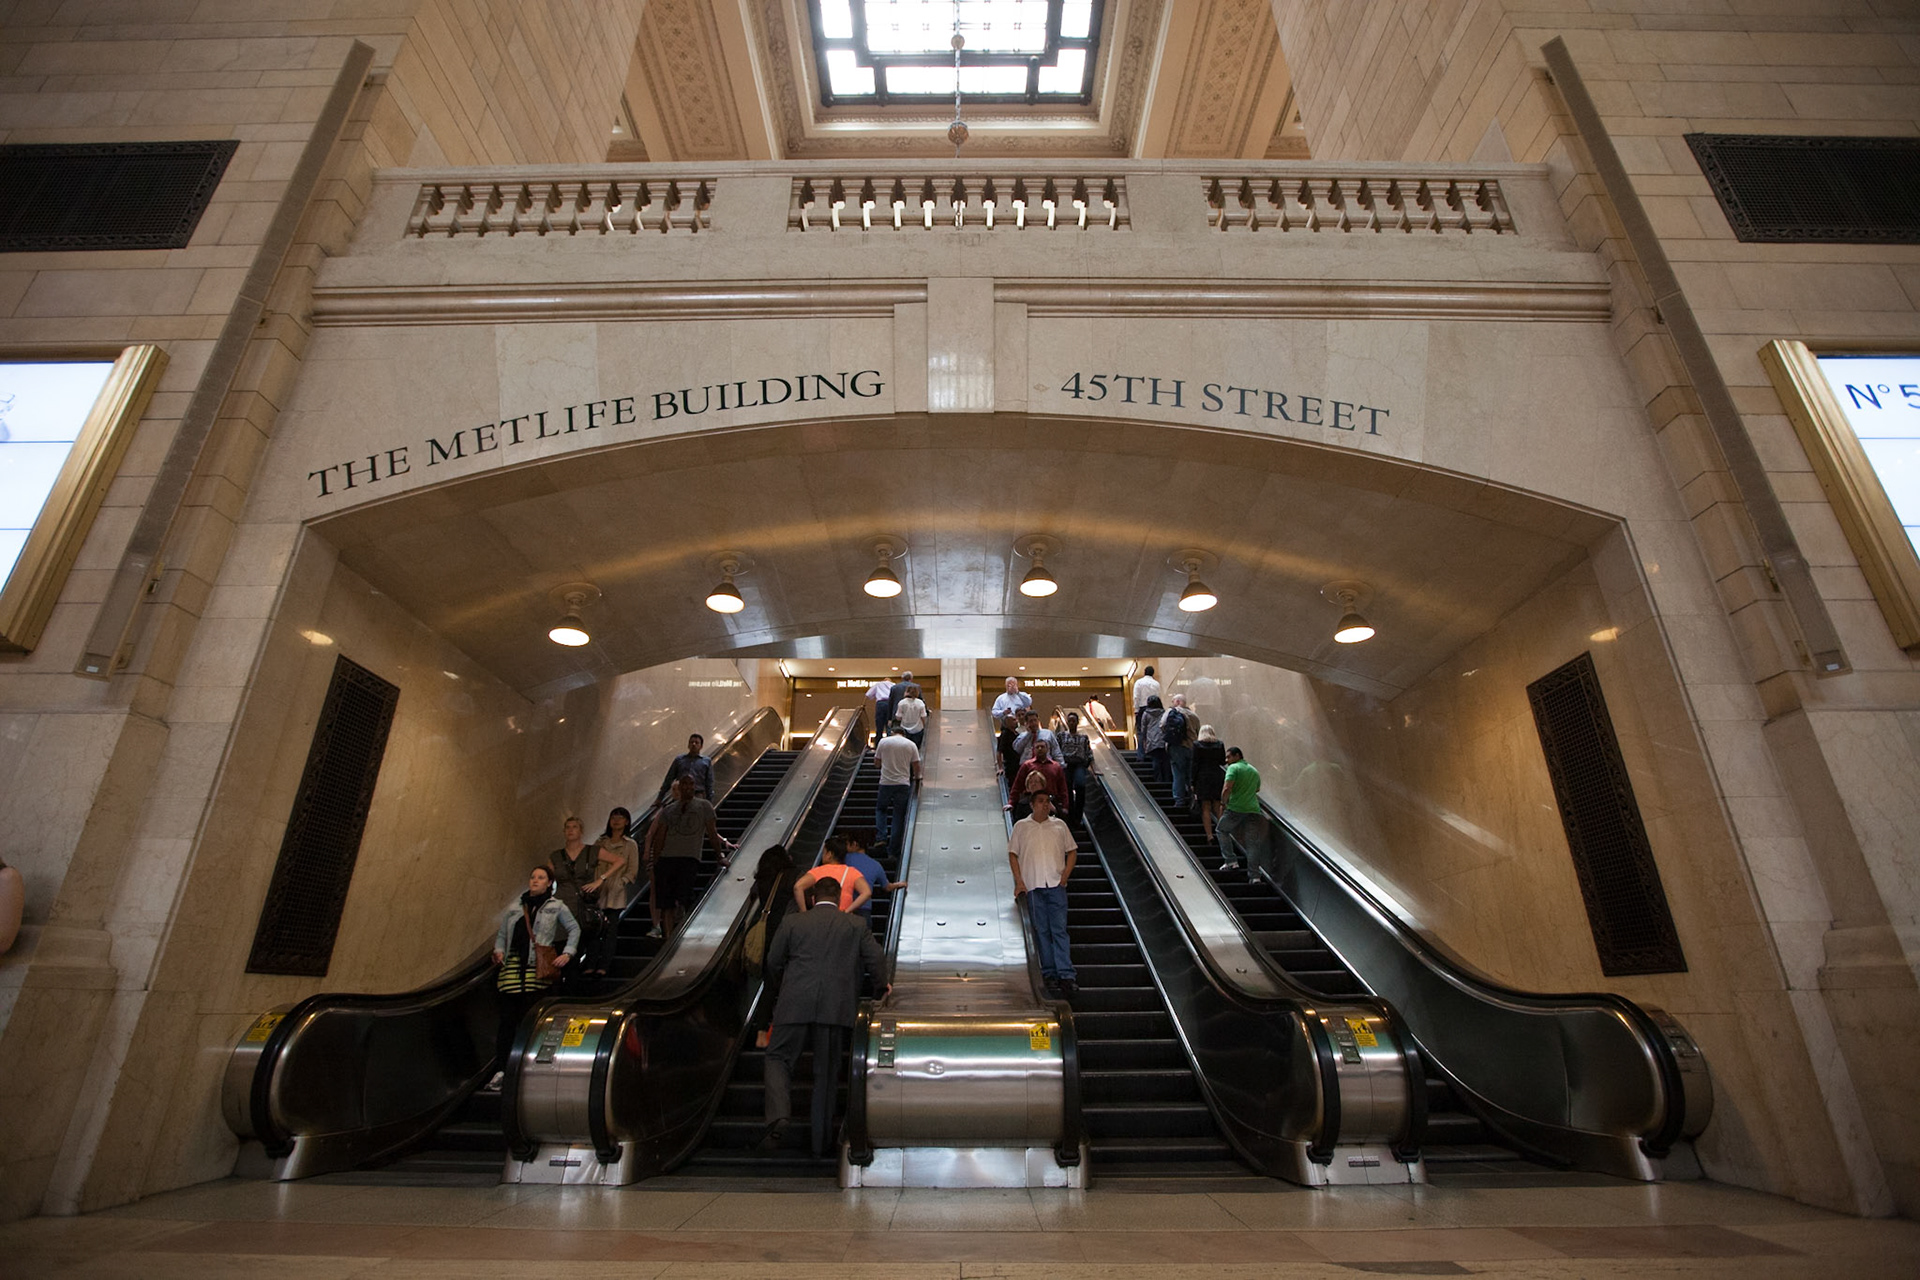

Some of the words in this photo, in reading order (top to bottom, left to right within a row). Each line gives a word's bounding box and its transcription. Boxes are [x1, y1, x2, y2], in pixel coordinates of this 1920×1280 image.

[308, 447, 411, 498] THE
[425, 397, 637, 467] METLIFE
[652, 370, 886, 420] BUILDING
[1061, 372, 1186, 408] 45TH
[1202, 383, 1390, 436] STREET
